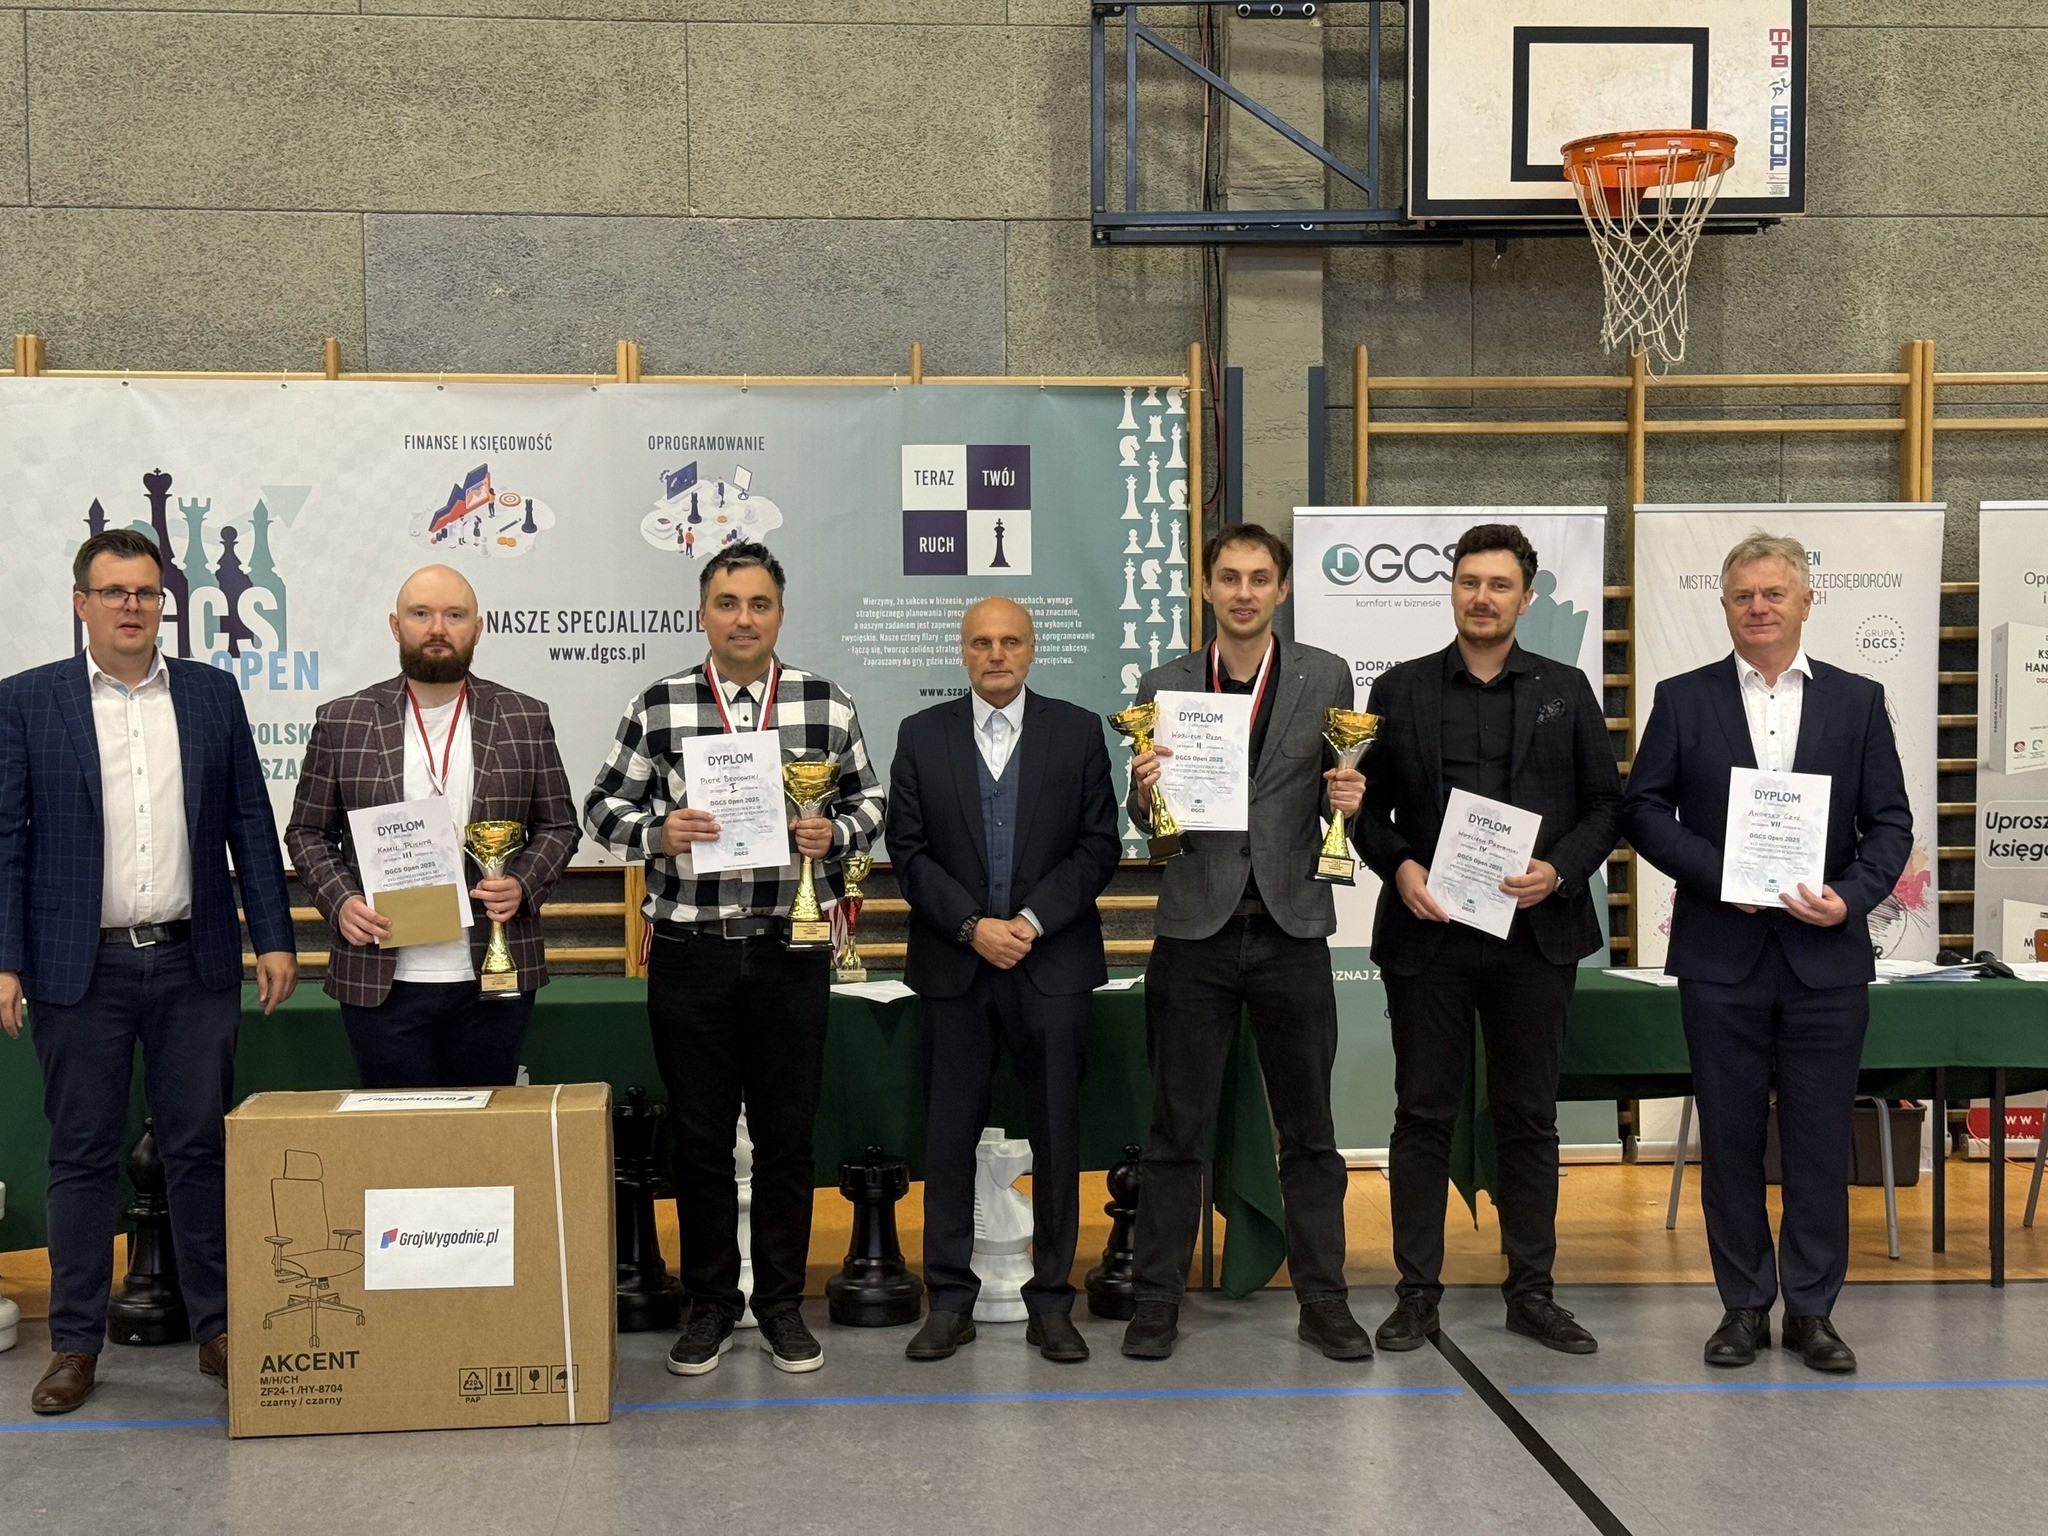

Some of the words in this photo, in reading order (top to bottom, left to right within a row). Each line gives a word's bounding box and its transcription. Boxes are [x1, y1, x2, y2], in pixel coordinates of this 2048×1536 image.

[1769, 28, 1791, 68] MTB
[404, 434, 459, 450] FINANSE
[463, 435, 466, 450] I
[471, 433, 553, 453] KSIĘGOWOŚĆ
[648, 435, 765, 451] OPROGRAMOWANIE
[914, 470, 954, 486] TERAZ
[982, 467, 1015, 487] TWÓJ
[920, 536, 954, 553] RUCH
[863, 597, 896, 607] Wierzymy,
[905, 596, 928, 605] sukces
[935, 596, 965, 606] biznesie,
[1047, 597, 1073, 606] wymaga
[1356, 599, 1392, 608] komfort
[1404, 599, 1441, 608] biznesie
[856, 609, 905, 619] strategicznego
[905, 609, 943, 619] planowania
[1046, 608, 1080, 617] znaczenie,
[487, 610, 550, 634] NASZE
[557, 610, 705, 633] SPECJALIZACJE
[859, 622, 884, 631] naszym
[884, 621, 916, 630] zadaniem
[916, 621, 930, 631] jest
[1044, 620, 1074, 630] wykonuje
[1075, 620, 1082, 628] te
[879, 633, 899, 641] Nasze
[900, 633, 921, 642] cztery
[922, 632, 939, 642] filary
[1042, 632, 1095, 642] oprogramowanie
[1864, 629, 1895, 638] GRUPA
[1862, 638, 1898, 649] DGCS
[549, 643, 646, 665] www.dgcs.pl
[851, 645, 870, 655] łączą
[883, 645, 909, 655] tworząc
[910, 645, 934, 655] solidną
[1040, 644, 1060, 652] realne
[863, 657, 901, 667] Zapraszamy
[902, 657, 911, 666] do
[912, 658, 925, 667] gry,
[925, 656, 944, 667] gdzie
[944, 656, 964, 667] każdy
[1034, 656, 1074, 666] zwycięstwa.
[1355, 661, 1403, 671] DORA
[1179, 711, 1223, 723] DYPLOM
[708, 753, 754, 766] DYPLOM
[1193, 755, 1208, 763] Open
[260, 758, 304, 780] SZA
[728, 798, 744, 807] Open
[745, 796, 760, 804] 2025
[1754, 789, 1801, 804] DYPLOM
[377, 819, 425, 837] DYPLOM
[1468, 813, 1512, 835] DYPLOM
[1767, 834, 1784, 842] Open
[1473, 857, 1488, 867] Open
[385, 867, 402, 876] DGCS
[403, 864, 420, 873] Open
[399, 1228, 500, 1248] GrajWygodnie.pl
[260, 1350, 360, 1374] AKCENT
[260, 1375, 299, 1385] M/H/CH
[260, 1386, 295, 1396] ZF24-1
[260, 1398, 297, 1408] czarny
[305, 1397, 342, 1406] czarny
